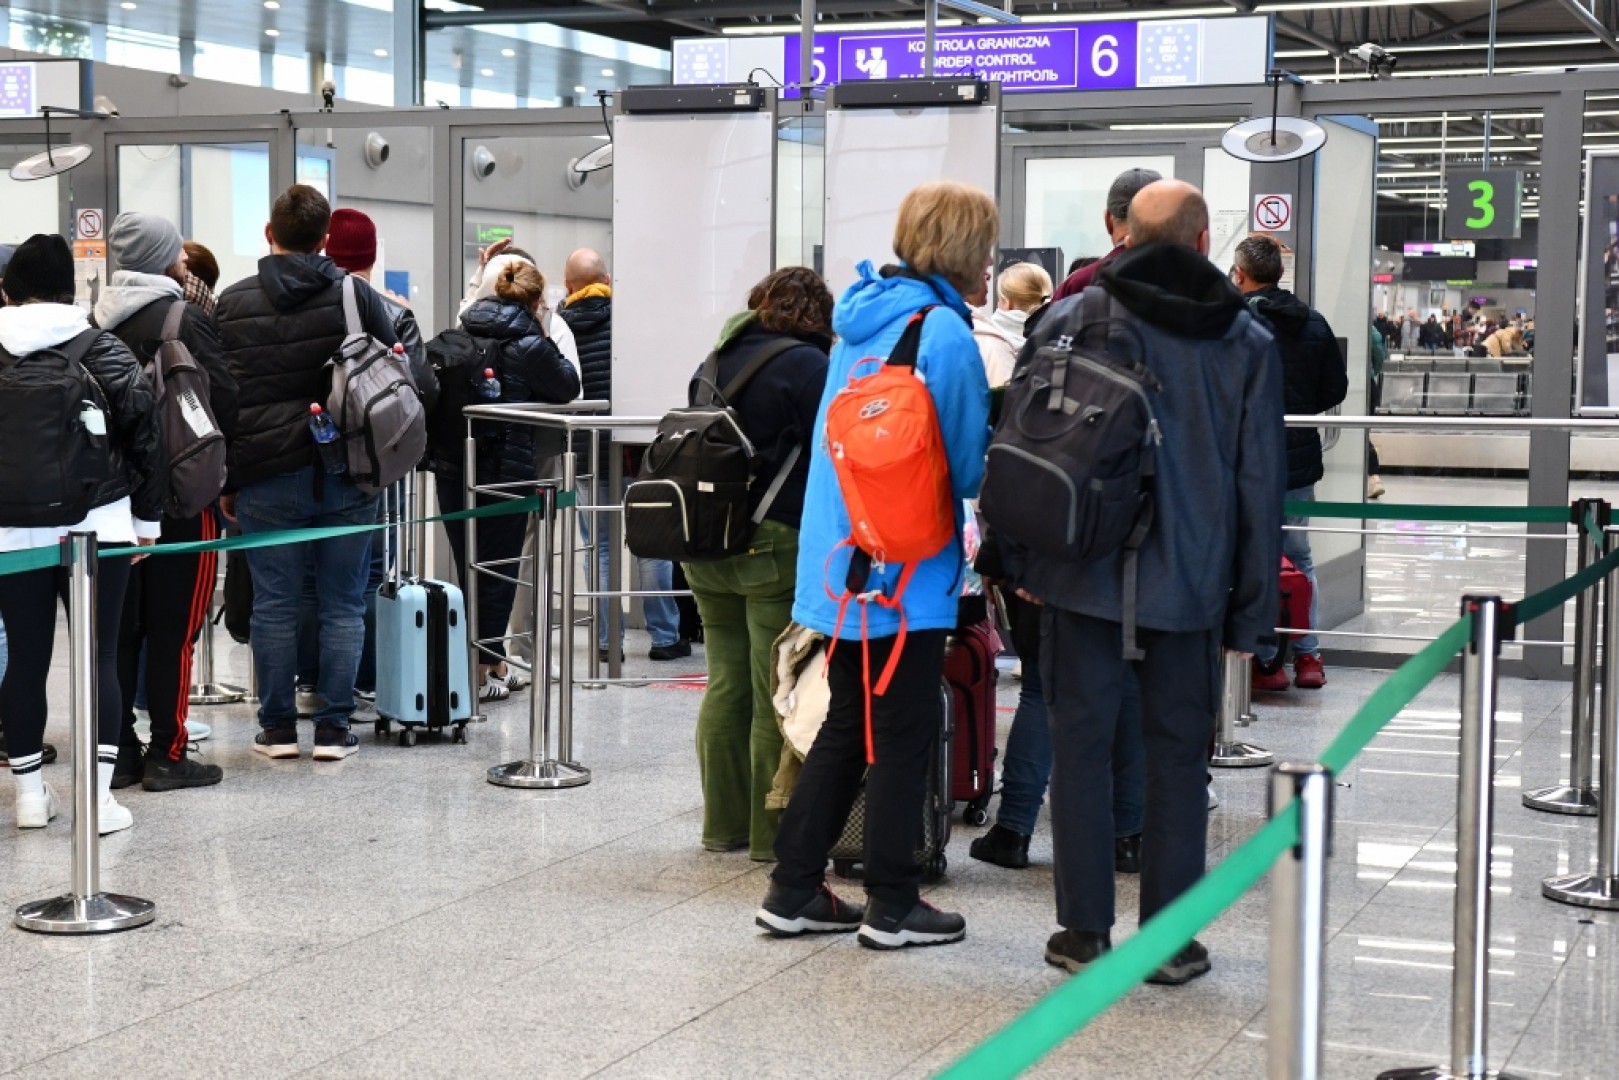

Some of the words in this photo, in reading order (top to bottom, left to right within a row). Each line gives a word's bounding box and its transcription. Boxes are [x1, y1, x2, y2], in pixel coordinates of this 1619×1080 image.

[908, 39, 974, 52] KOTROLA
[977, 36, 1050, 50] GRANICZNA
[975, 53, 1037, 66] CONTROL
[1091, 34, 1118, 77] 6
[989, 69, 1058, 83] КОНТРОЛЬ
[1466, 180, 1494, 228] 3
